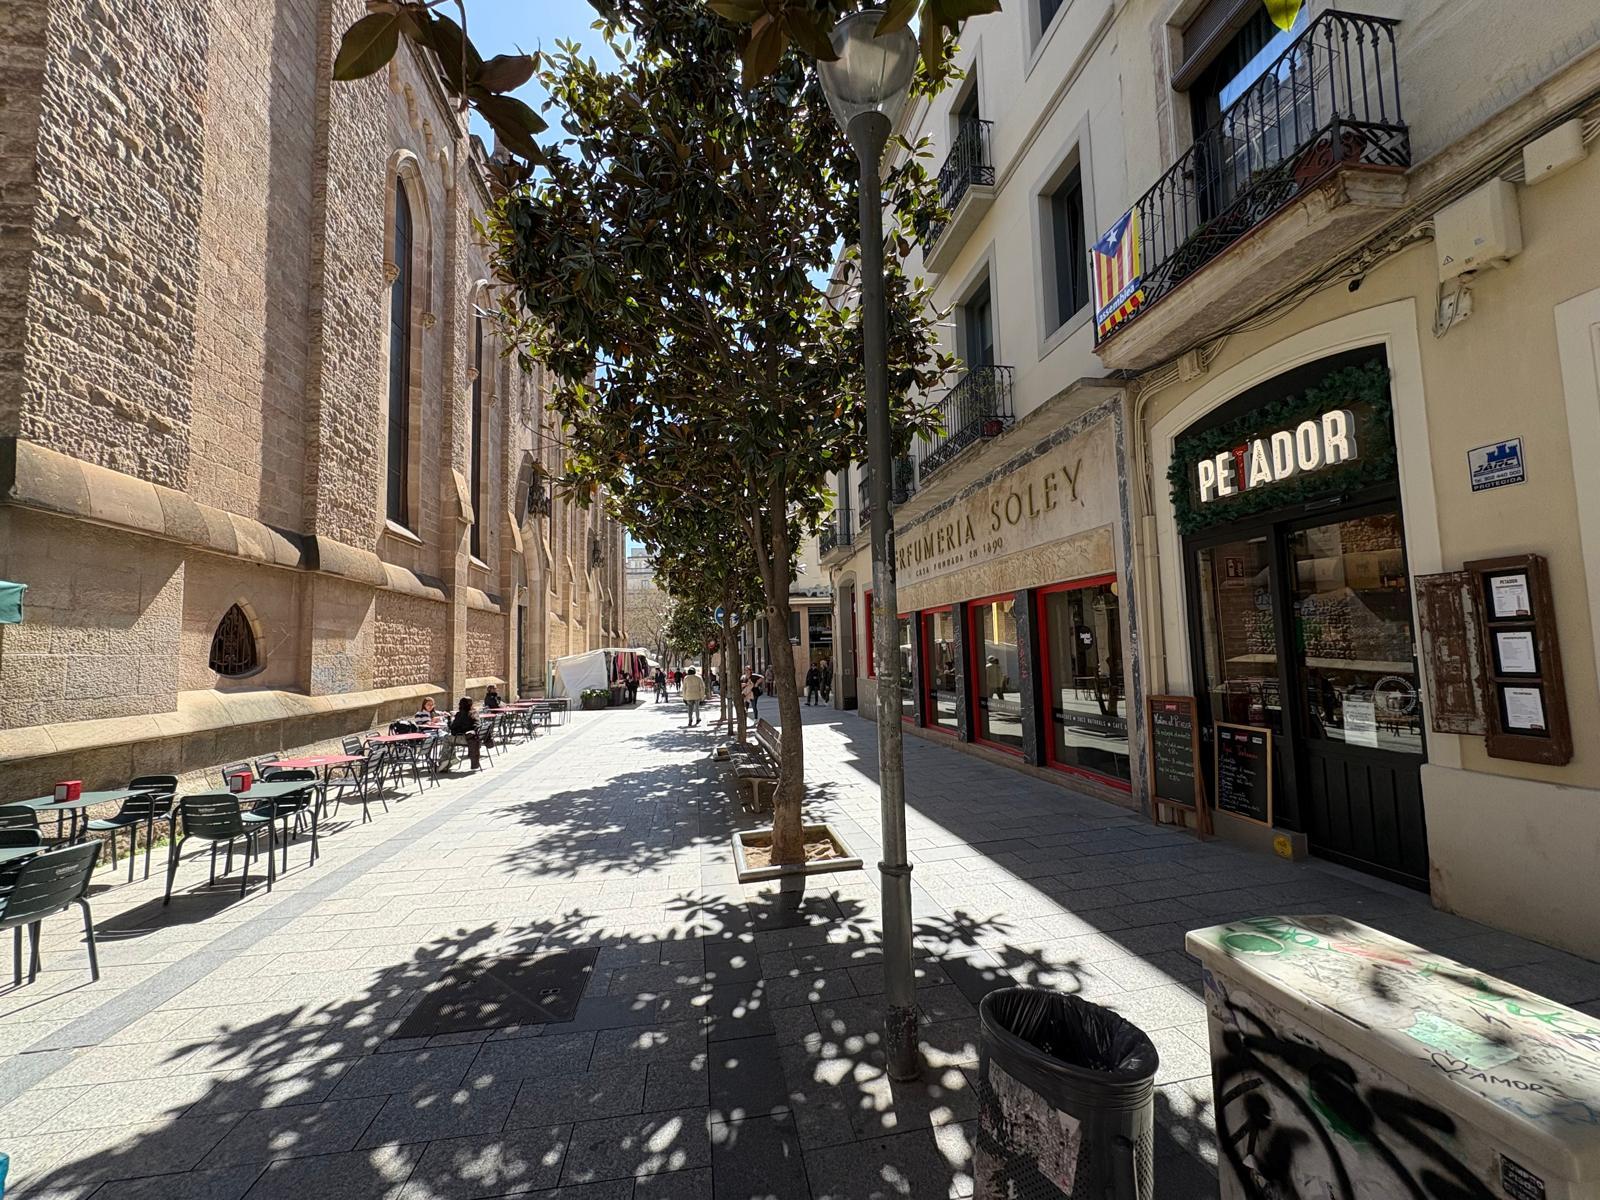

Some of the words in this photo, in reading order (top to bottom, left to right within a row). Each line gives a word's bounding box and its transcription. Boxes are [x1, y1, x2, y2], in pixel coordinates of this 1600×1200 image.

[1098, 284, 1135, 322] assemblea
[1197, 409, 1355, 503] PETADOR
[1473, 477, 1522, 490] PROTEGIDA
[895, 515, 976, 572] RFUMERIA
[990, 459, 1083, 532] SOLEY
[916, 567, 930, 577] CASA
[933, 553, 964, 570] FUNDADA
[983, 536, 1003, 555] 1890
[1470, 1072, 1552, 1097] AMOR
